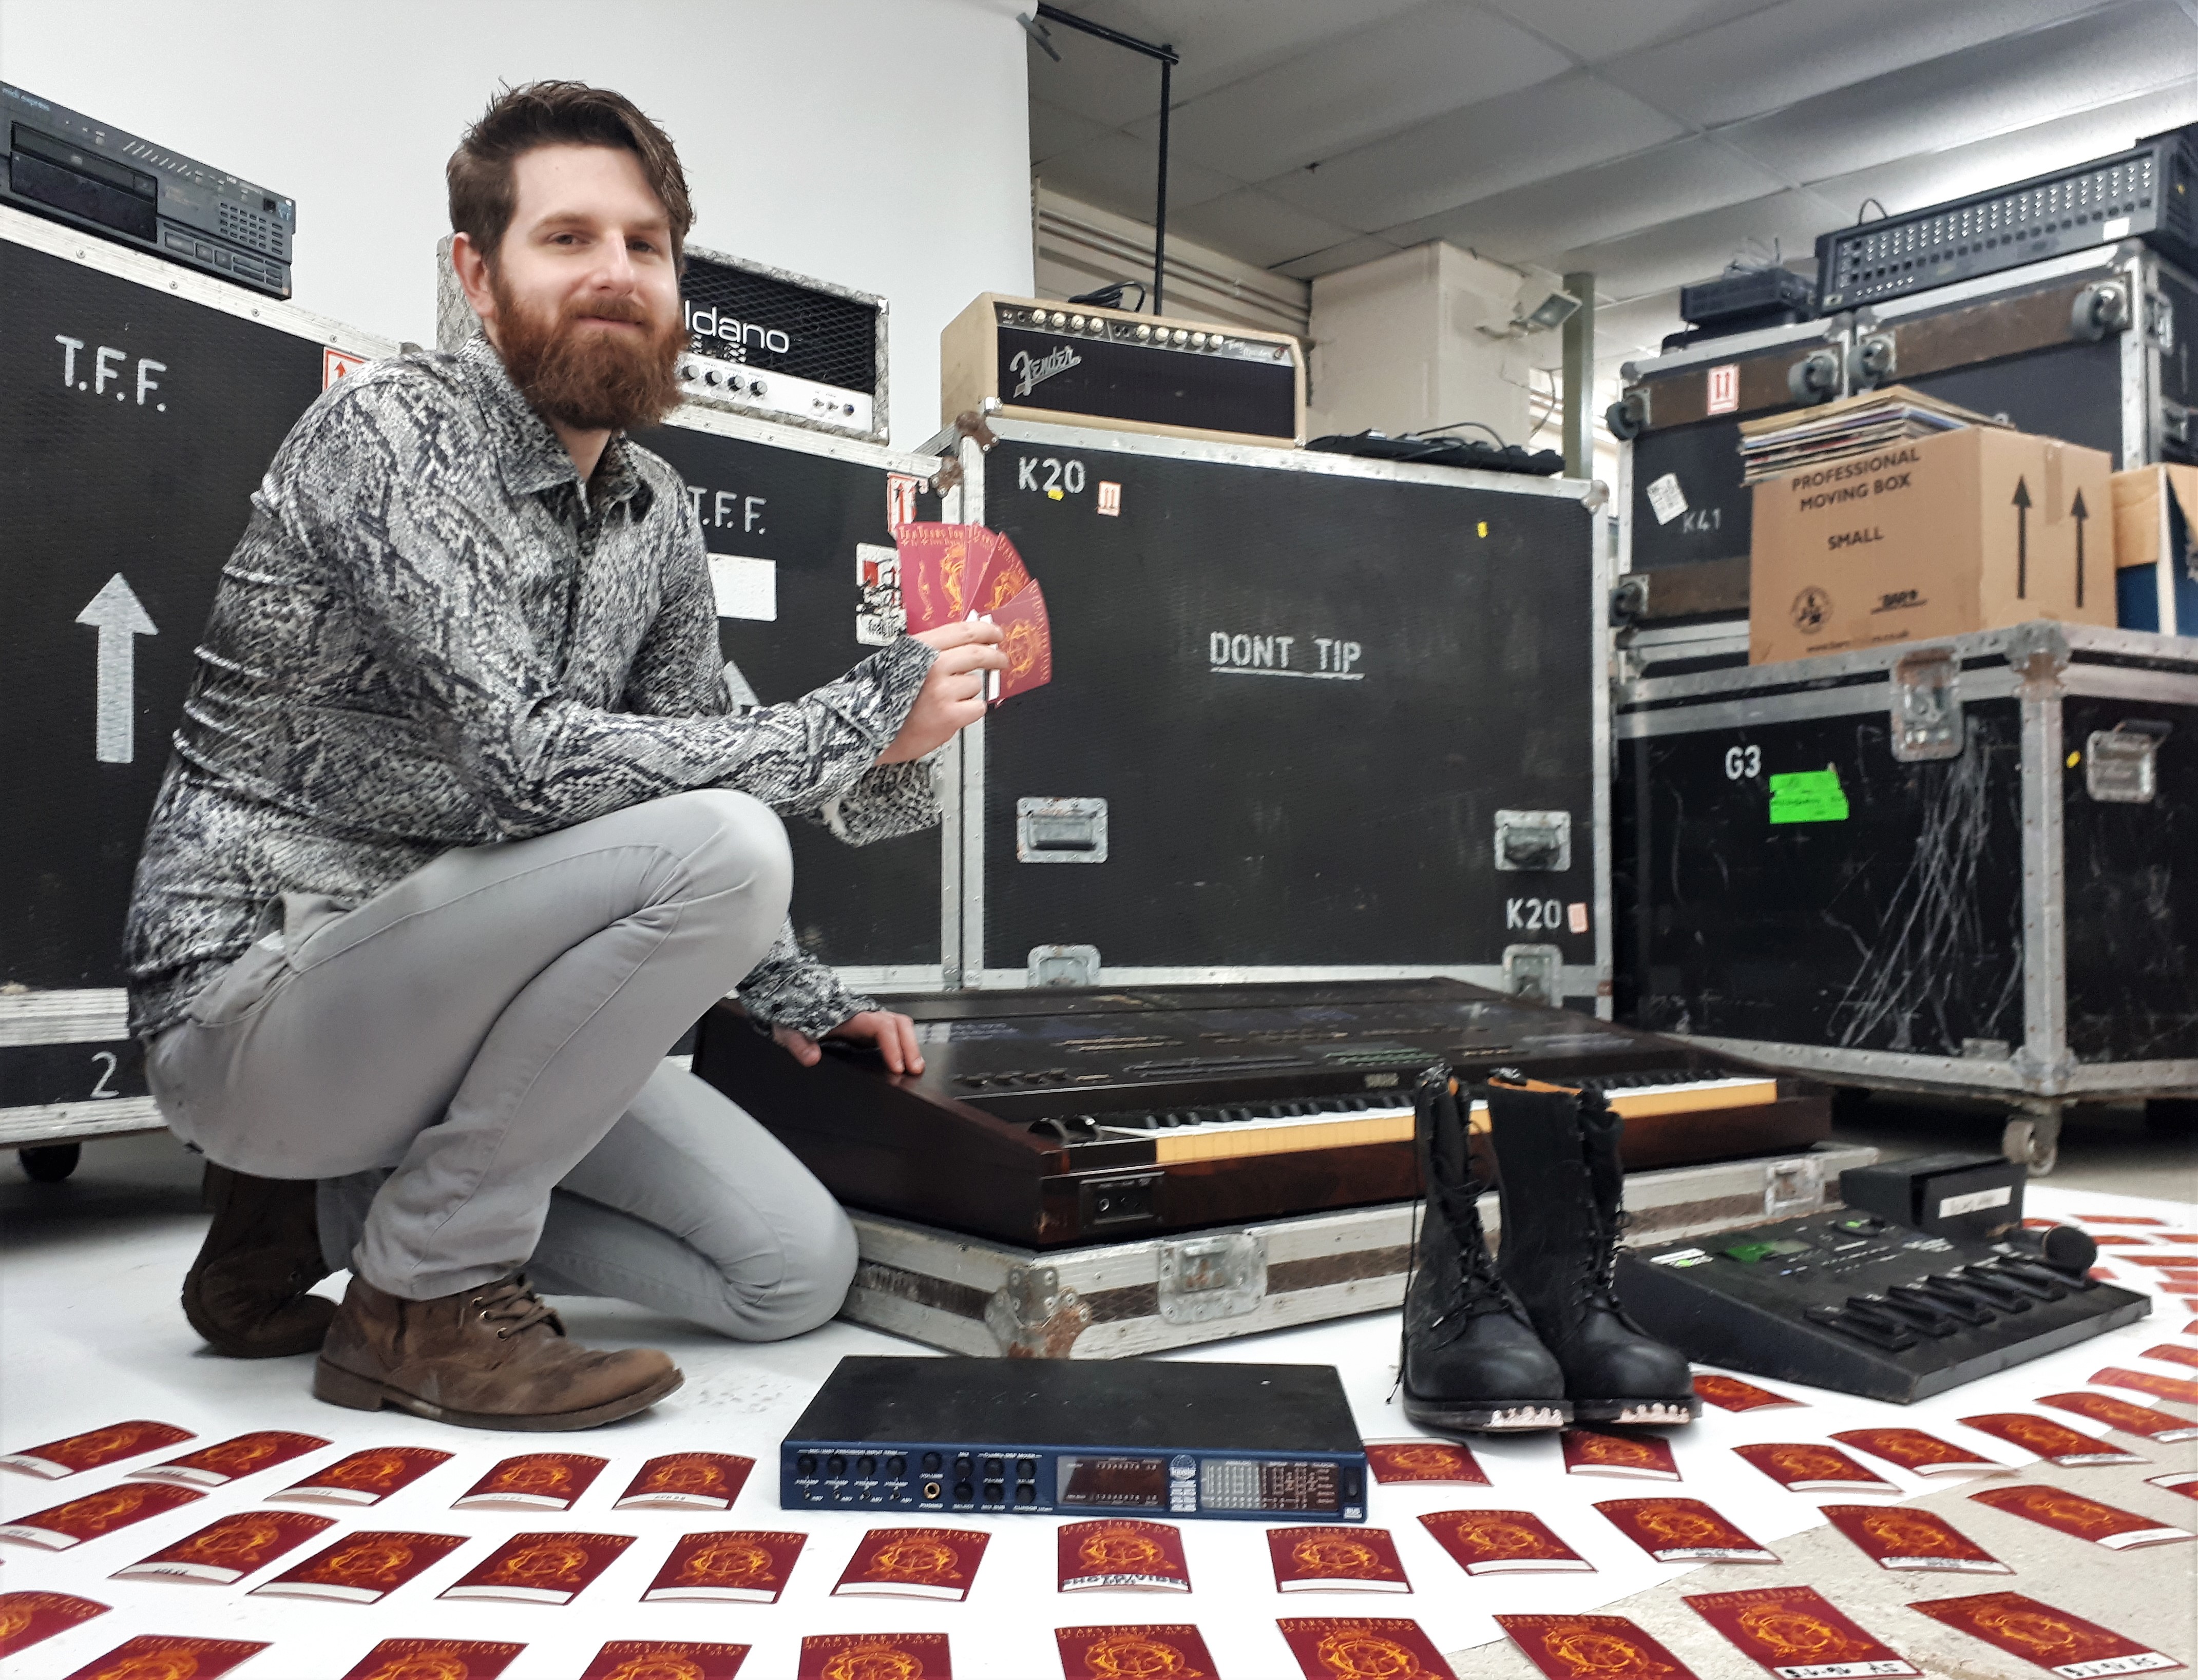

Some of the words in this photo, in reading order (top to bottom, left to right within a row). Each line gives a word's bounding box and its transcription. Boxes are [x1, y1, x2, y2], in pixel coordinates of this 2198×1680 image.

[55, 334, 168, 413] T.F.F.
[1010, 344, 1082, 398] Fender
[1018, 456, 1086, 494] K20
[1792, 448, 1920, 490] PROFESSIONAL
[687, 485, 768, 535] T.F.F.
[1800, 484, 1868, 511] MOVING
[1874, 473, 1912, 493] BOX
[1683, 509, 1722, 534] K41
[1827, 527, 1884, 550] SMALL
[1210, 630, 1295, 669] DONT
[1312, 636, 1363, 673] TIP
[1725, 746, 1762, 778] G3
[1506, 899, 1563, 930] K20
[90, 1051, 120, 1099] 2
